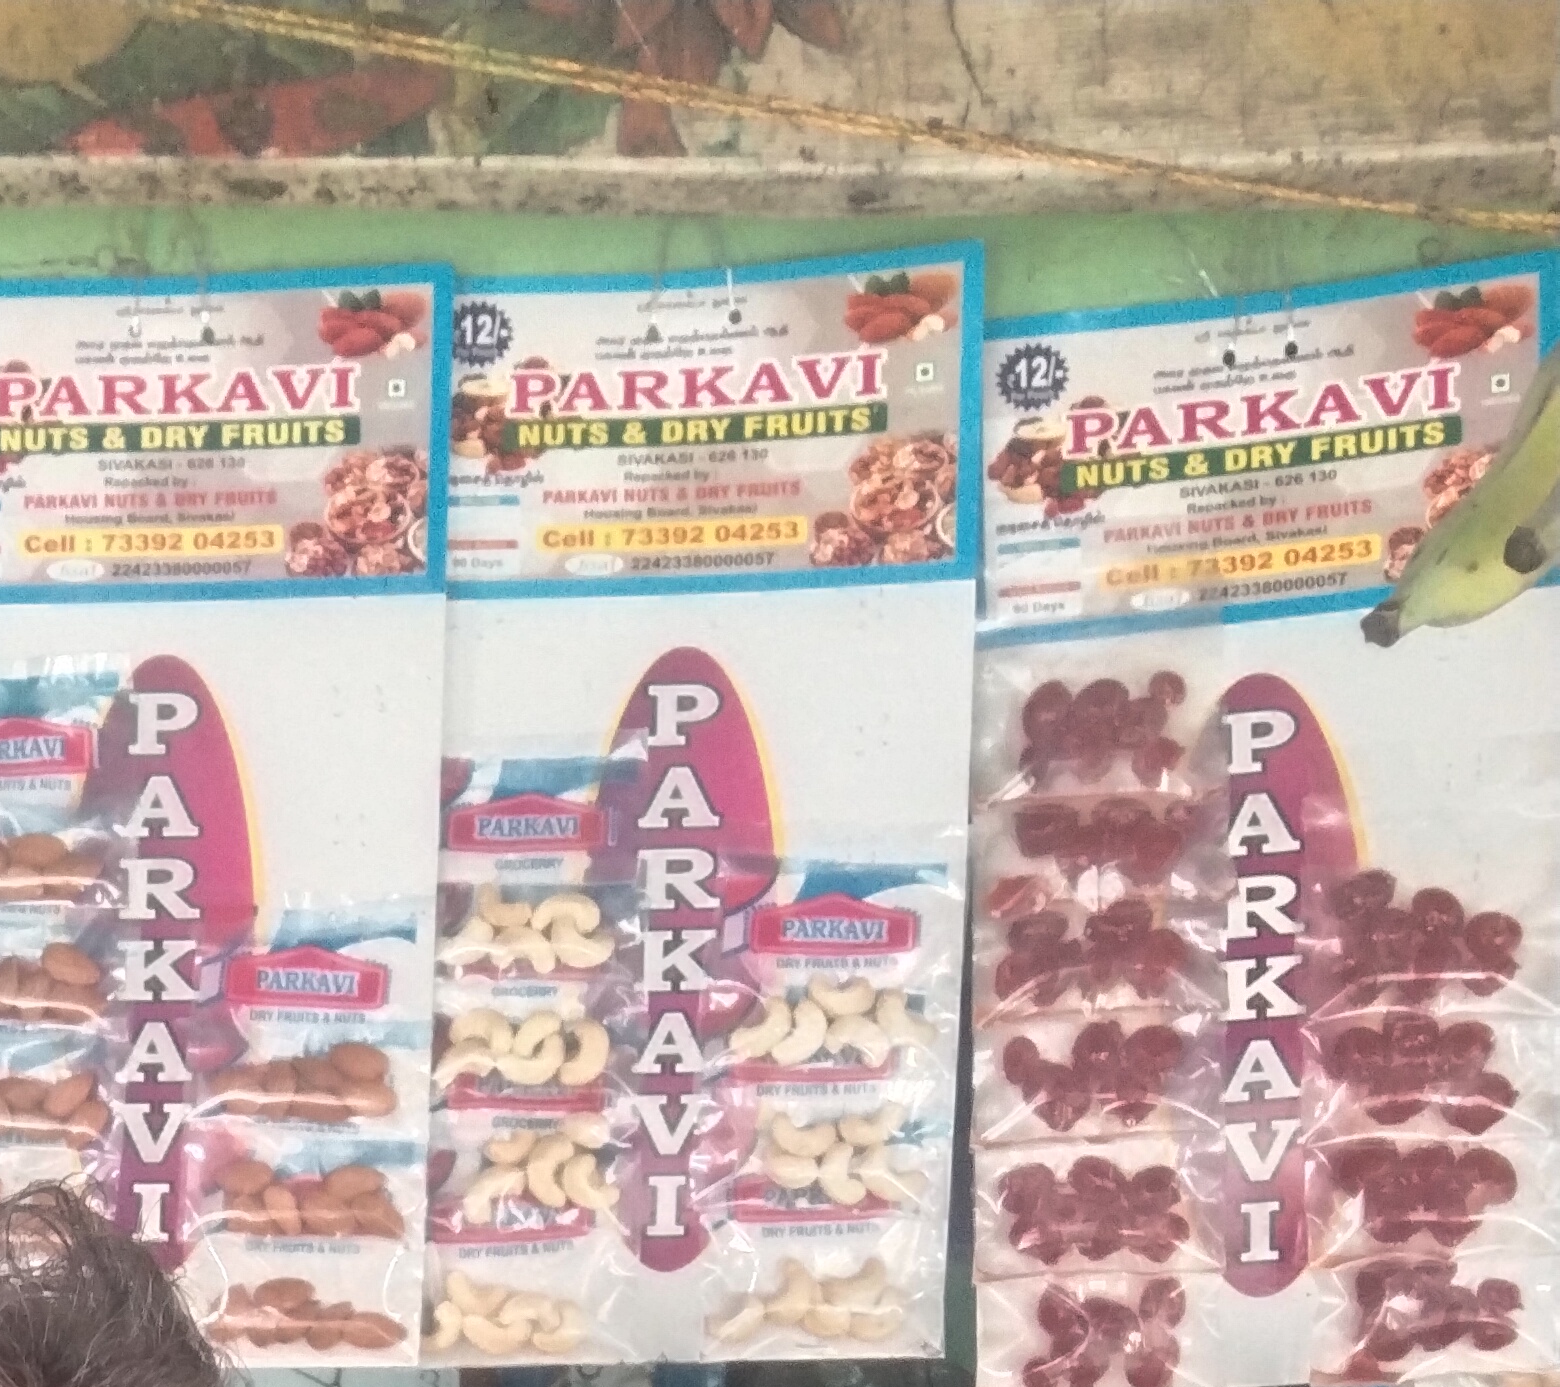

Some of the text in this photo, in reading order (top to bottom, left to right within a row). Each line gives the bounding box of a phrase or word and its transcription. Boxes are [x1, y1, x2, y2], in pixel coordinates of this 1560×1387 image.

[511, 353, 883, 413] PARKAVI
[518, 407, 872, 448] NUTS & DRY FRUITS
[1066, 367, 1456, 455] PARKAVI
[0, 419, 346, 452] NUTS & DRY FRUITS
[1076, 421, 1446, 489] NUTS & DRY FRUITS
[25, 534, 77, 553] Cell
[102, 532, 183, 552] 73392
[193, 530, 275, 550] 04253
[543, 529, 595, 548] Cell
[622, 525, 705, 546] 73392
[715, 520, 799, 543] 04253
[1106, 563, 1160, 586] Cell
[1283, 538, 1373, 567] 04253
[478, 816, 579, 837] PARKAVI
[782, 918, 884, 940] PARKAVI
[116, 692, 200, 1243] PARKAVI
[257, 970, 356, 995] PARKAVI
[637, 684, 721, 1237] PARKAVI
[1220, 709, 1302, 1264] PARKAVI
